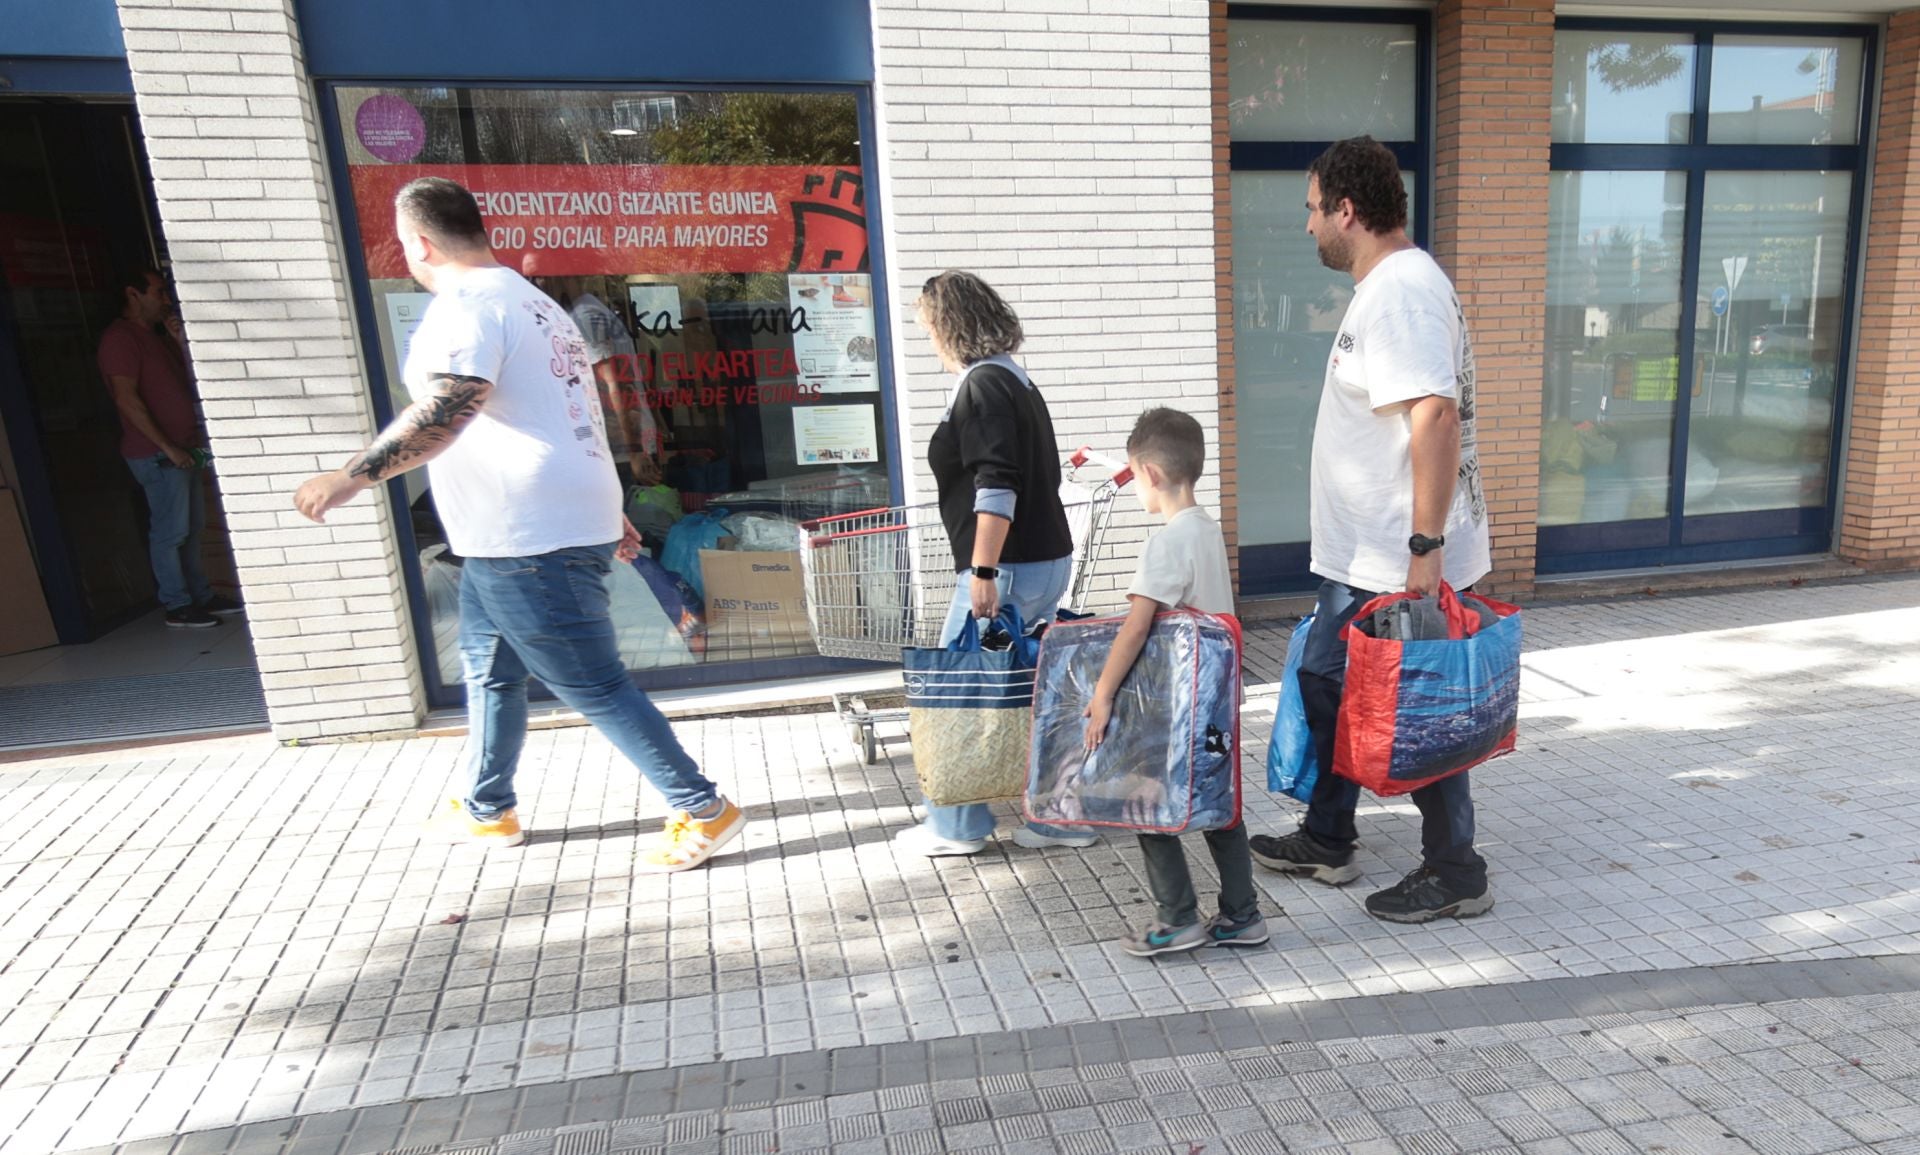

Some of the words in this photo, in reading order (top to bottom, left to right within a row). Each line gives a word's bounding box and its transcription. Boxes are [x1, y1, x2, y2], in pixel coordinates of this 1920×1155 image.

[472, 192, 613, 217] EKOENTZAKO
[619, 191, 704, 216] GIZARTE
[709, 191, 779, 215] GUNEA
[490, 226, 526, 250] CIO
[532, 226, 607, 249] SOCIAL
[614, 225, 668, 248] PARA
[674, 224, 769, 247] MAYORES
[663, 349, 800, 381] ELKARTEA
[701, 386, 728, 406] DE
[734, 383, 823, 405] VECINOS
[744, 600, 780, 610] Pants
